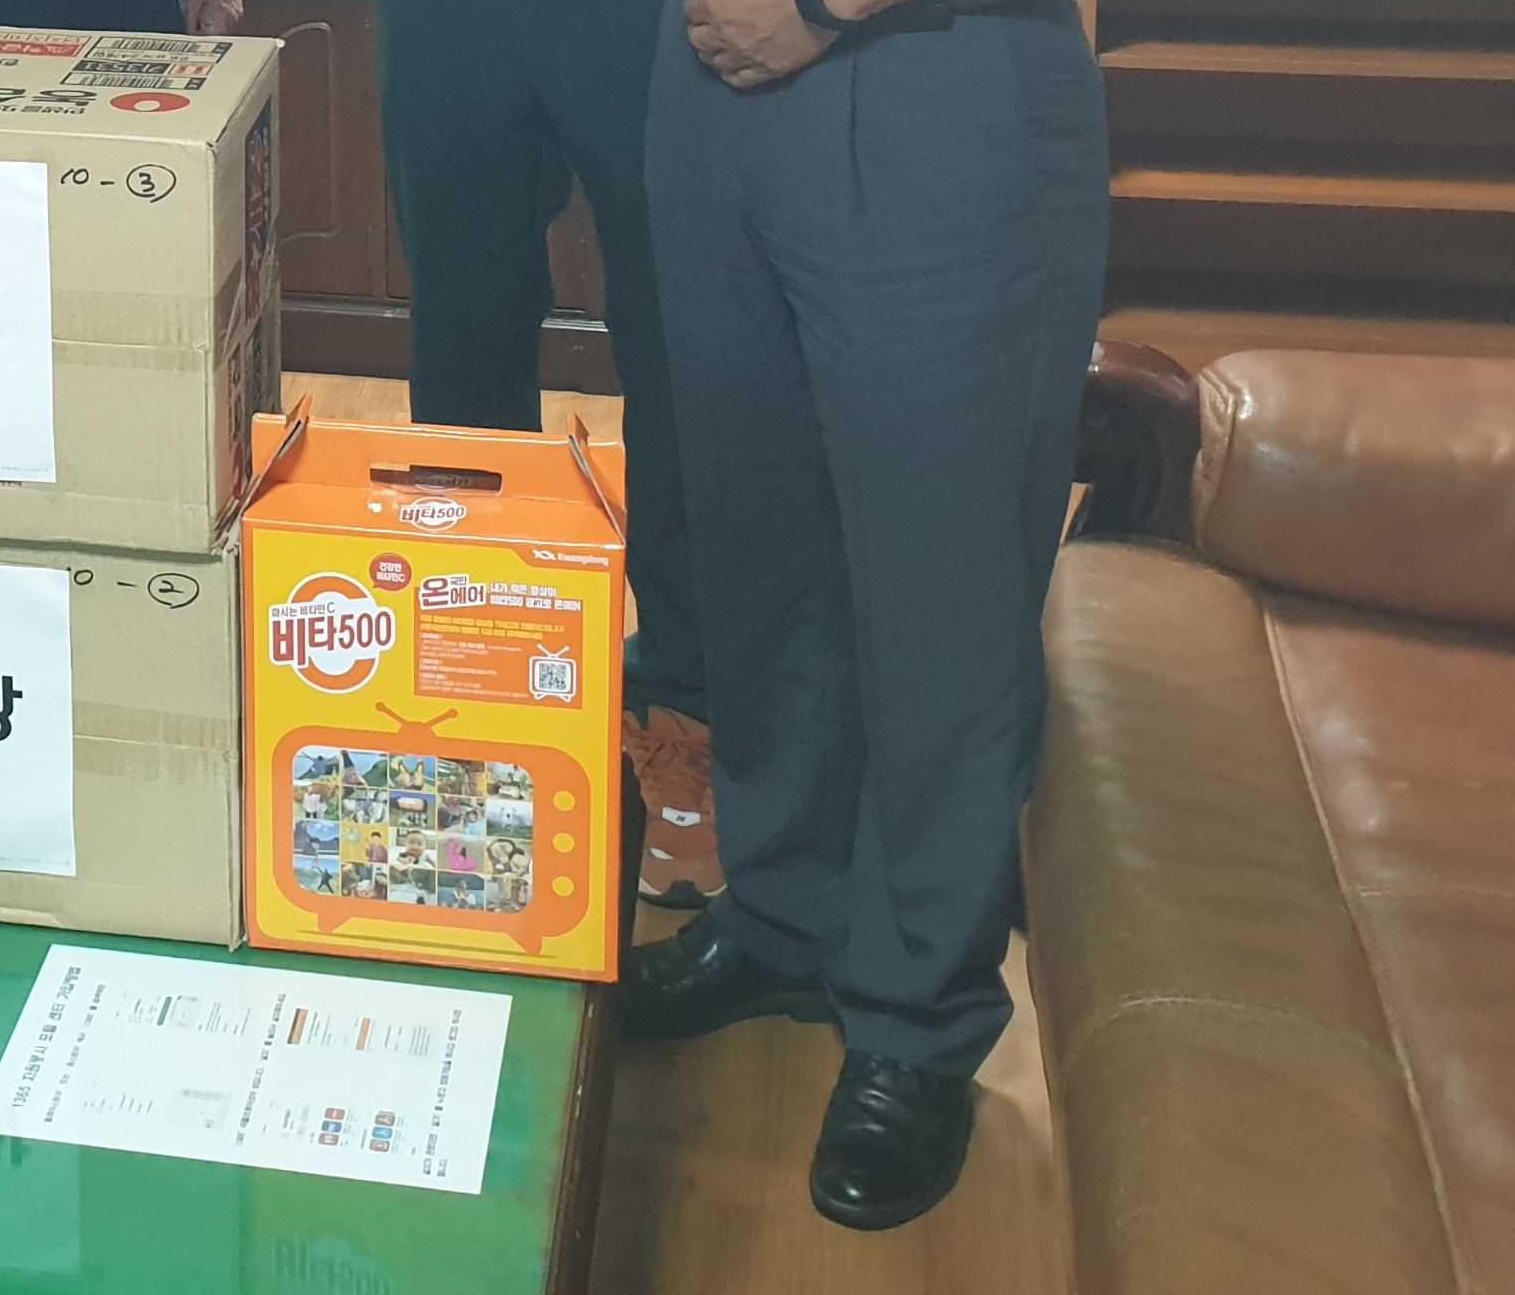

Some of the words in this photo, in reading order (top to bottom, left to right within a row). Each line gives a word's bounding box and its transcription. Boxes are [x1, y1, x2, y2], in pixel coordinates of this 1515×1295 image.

[401, 507, 465, 523] 비타500
[272, 607, 298, 618] 마시는
[272, 611, 393, 666] 비타500
[12, 1085, 32, 1108] 1365
